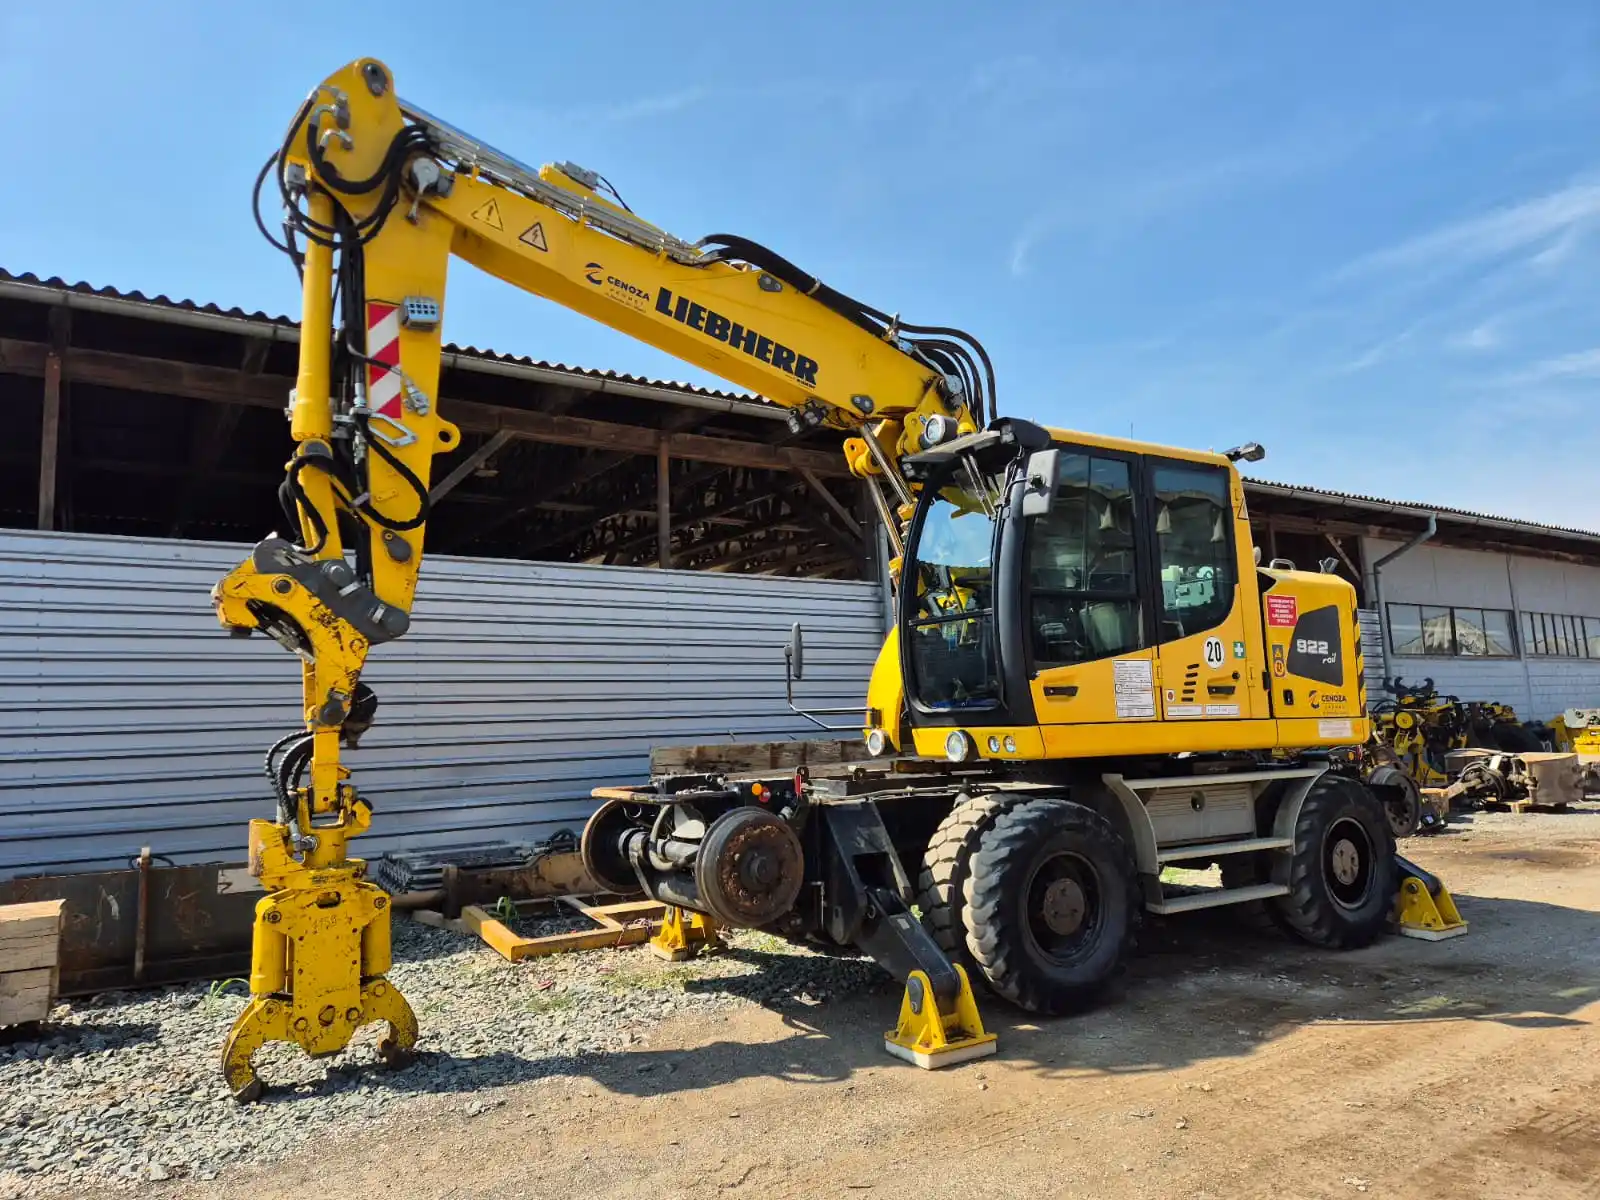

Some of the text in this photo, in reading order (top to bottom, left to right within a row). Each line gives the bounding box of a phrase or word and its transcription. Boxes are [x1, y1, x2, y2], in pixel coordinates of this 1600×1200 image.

[607, 276, 650, 302] CENOZA
[655, 287, 819, 385] LIEBHERR
[1206, 641, 1222, 662] 20
[1296, 639, 1329, 655] 922
[1322, 652, 1337, 665] rail
[1321, 694, 1347, 703] CENOZA
